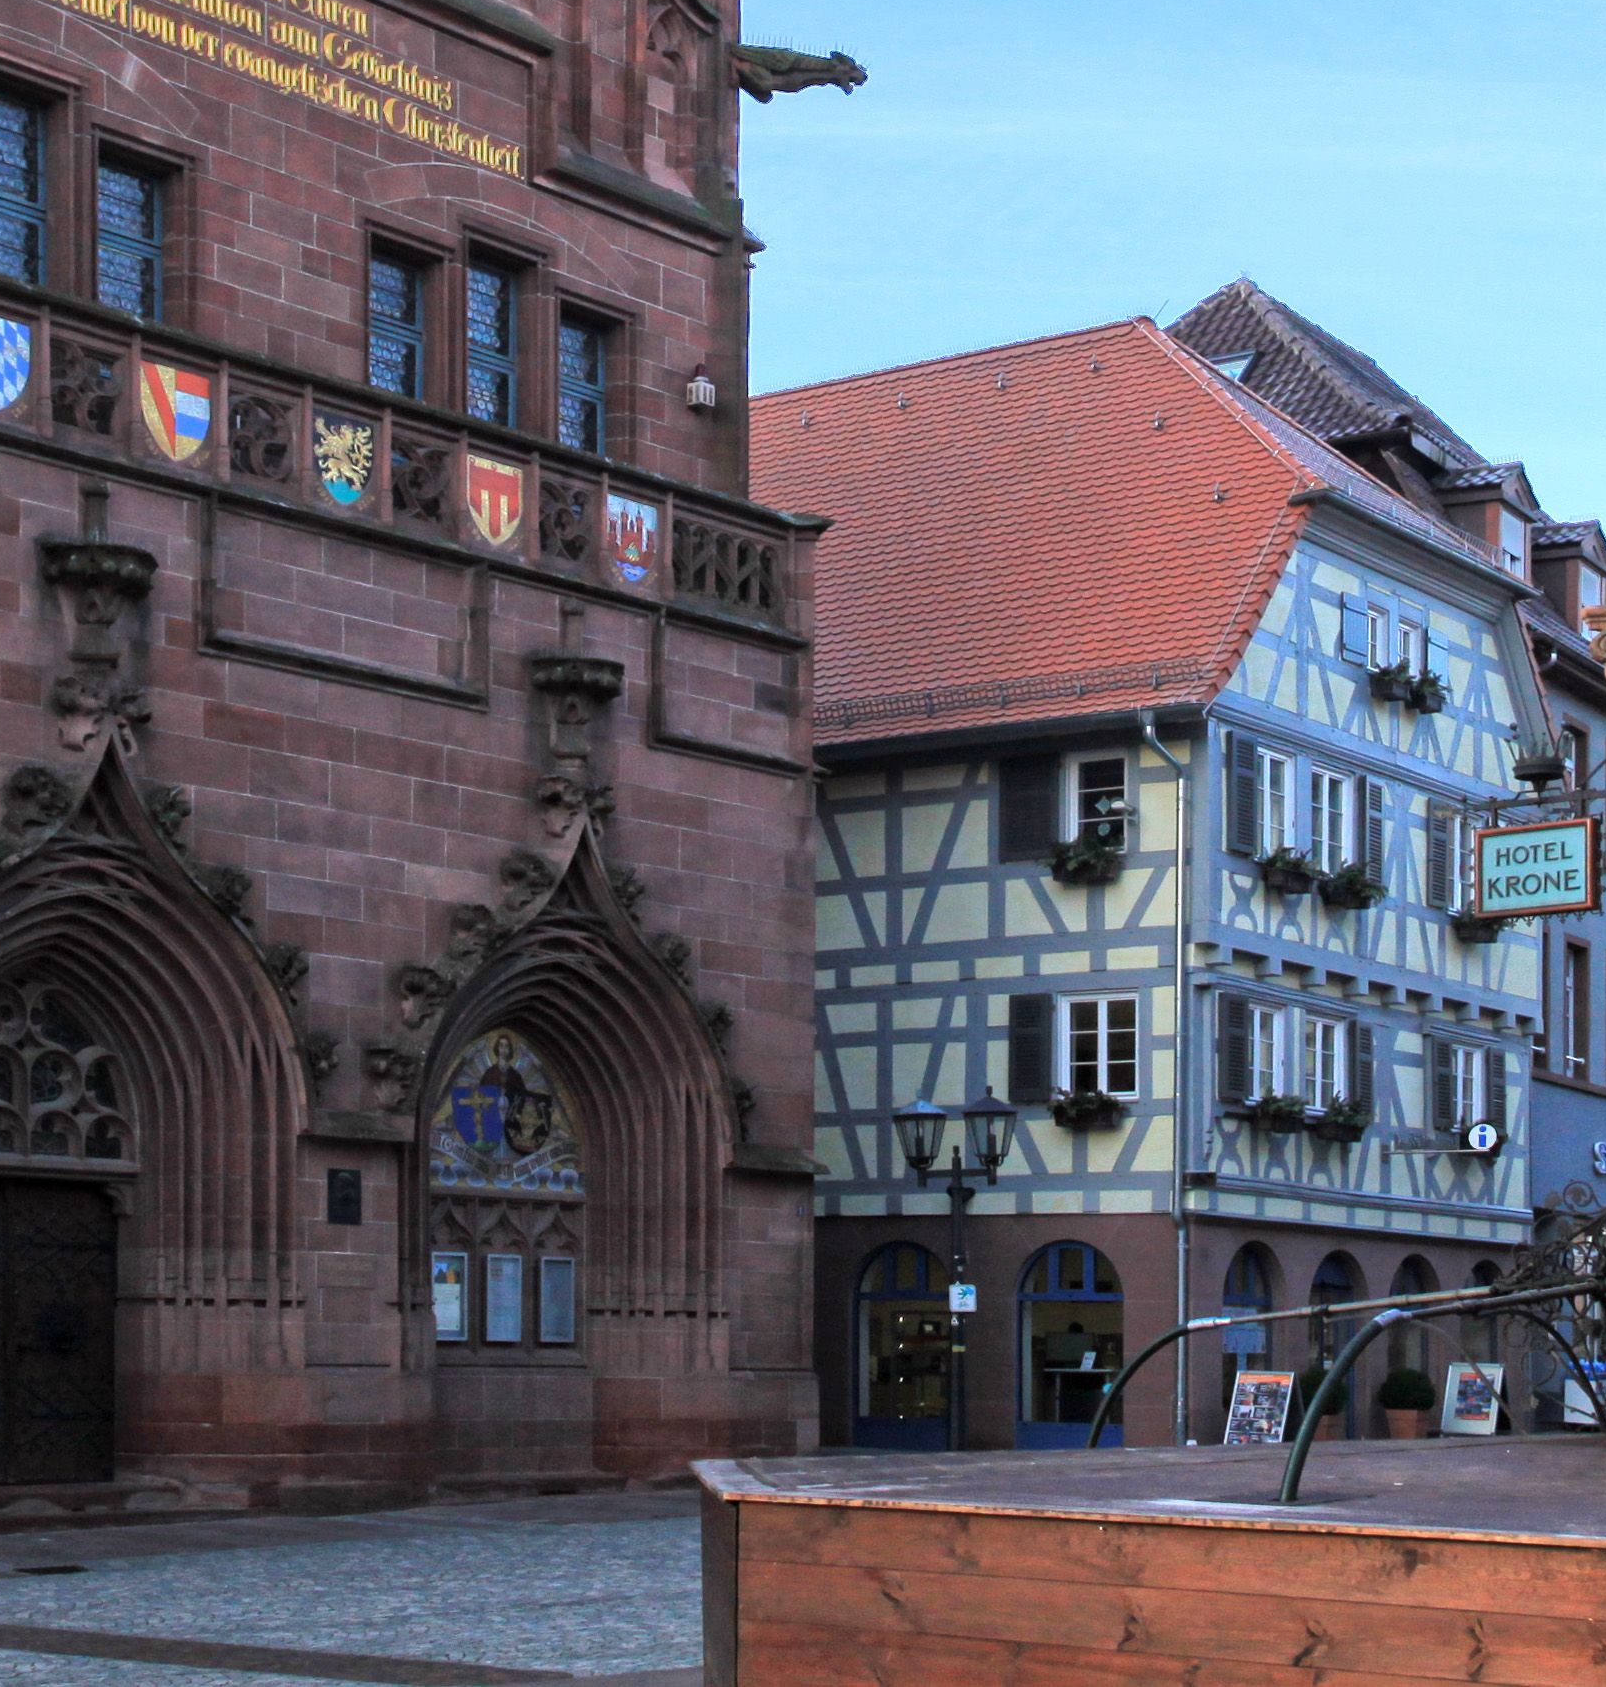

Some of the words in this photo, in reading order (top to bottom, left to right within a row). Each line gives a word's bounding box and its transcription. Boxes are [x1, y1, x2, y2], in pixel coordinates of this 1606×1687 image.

[132, 4, 177, 46] von
[181, 22, 220, 61] der
[270, 15, 320, 59] zum
[1496, 841, 1573, 867] HOTEL
[1487, 869, 1581, 899] KRONE
